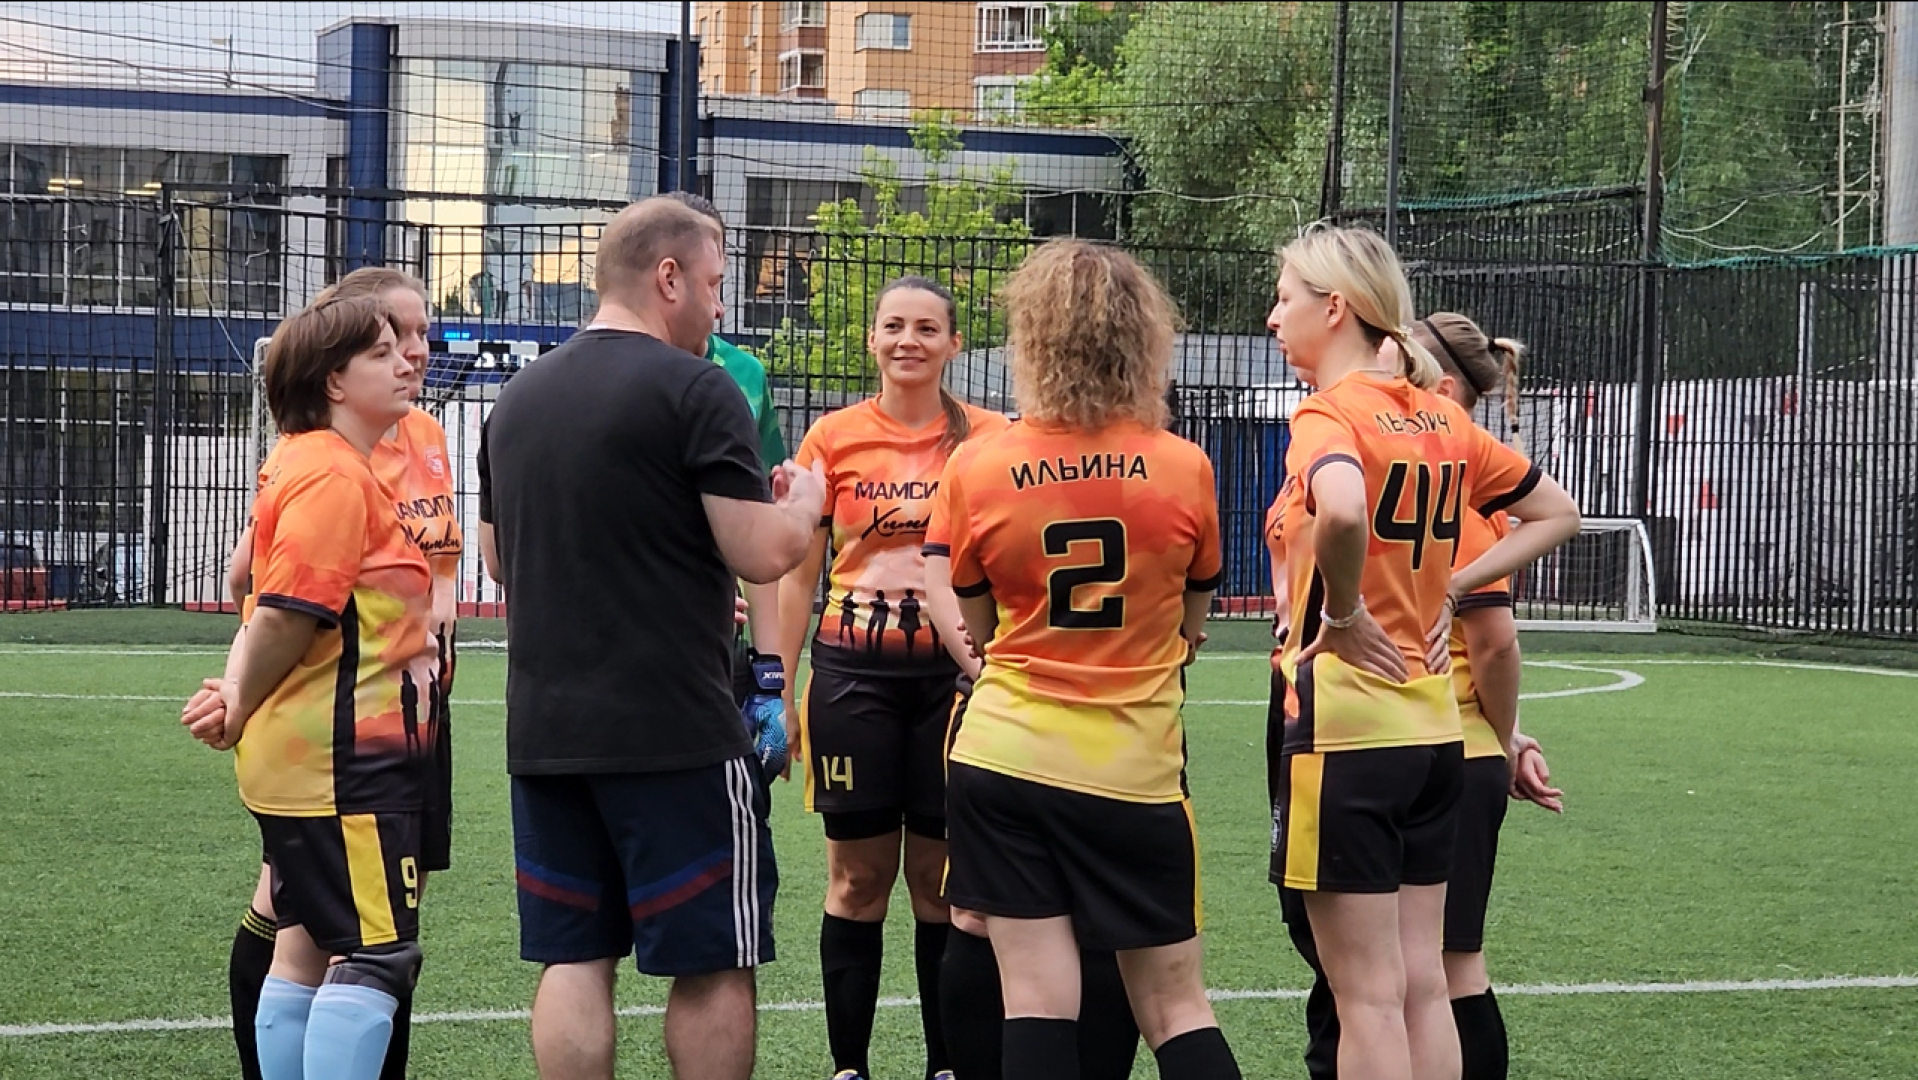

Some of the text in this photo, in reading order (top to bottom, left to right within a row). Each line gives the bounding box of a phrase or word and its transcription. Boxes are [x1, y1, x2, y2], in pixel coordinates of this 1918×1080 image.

[1010, 453, 1148, 491] ИЛЬИНА
[1373, 460, 1468, 573] 44
[1041, 517, 1128, 631] 2
[821, 755, 854, 791] 14
[400, 856, 418, 909] 9
